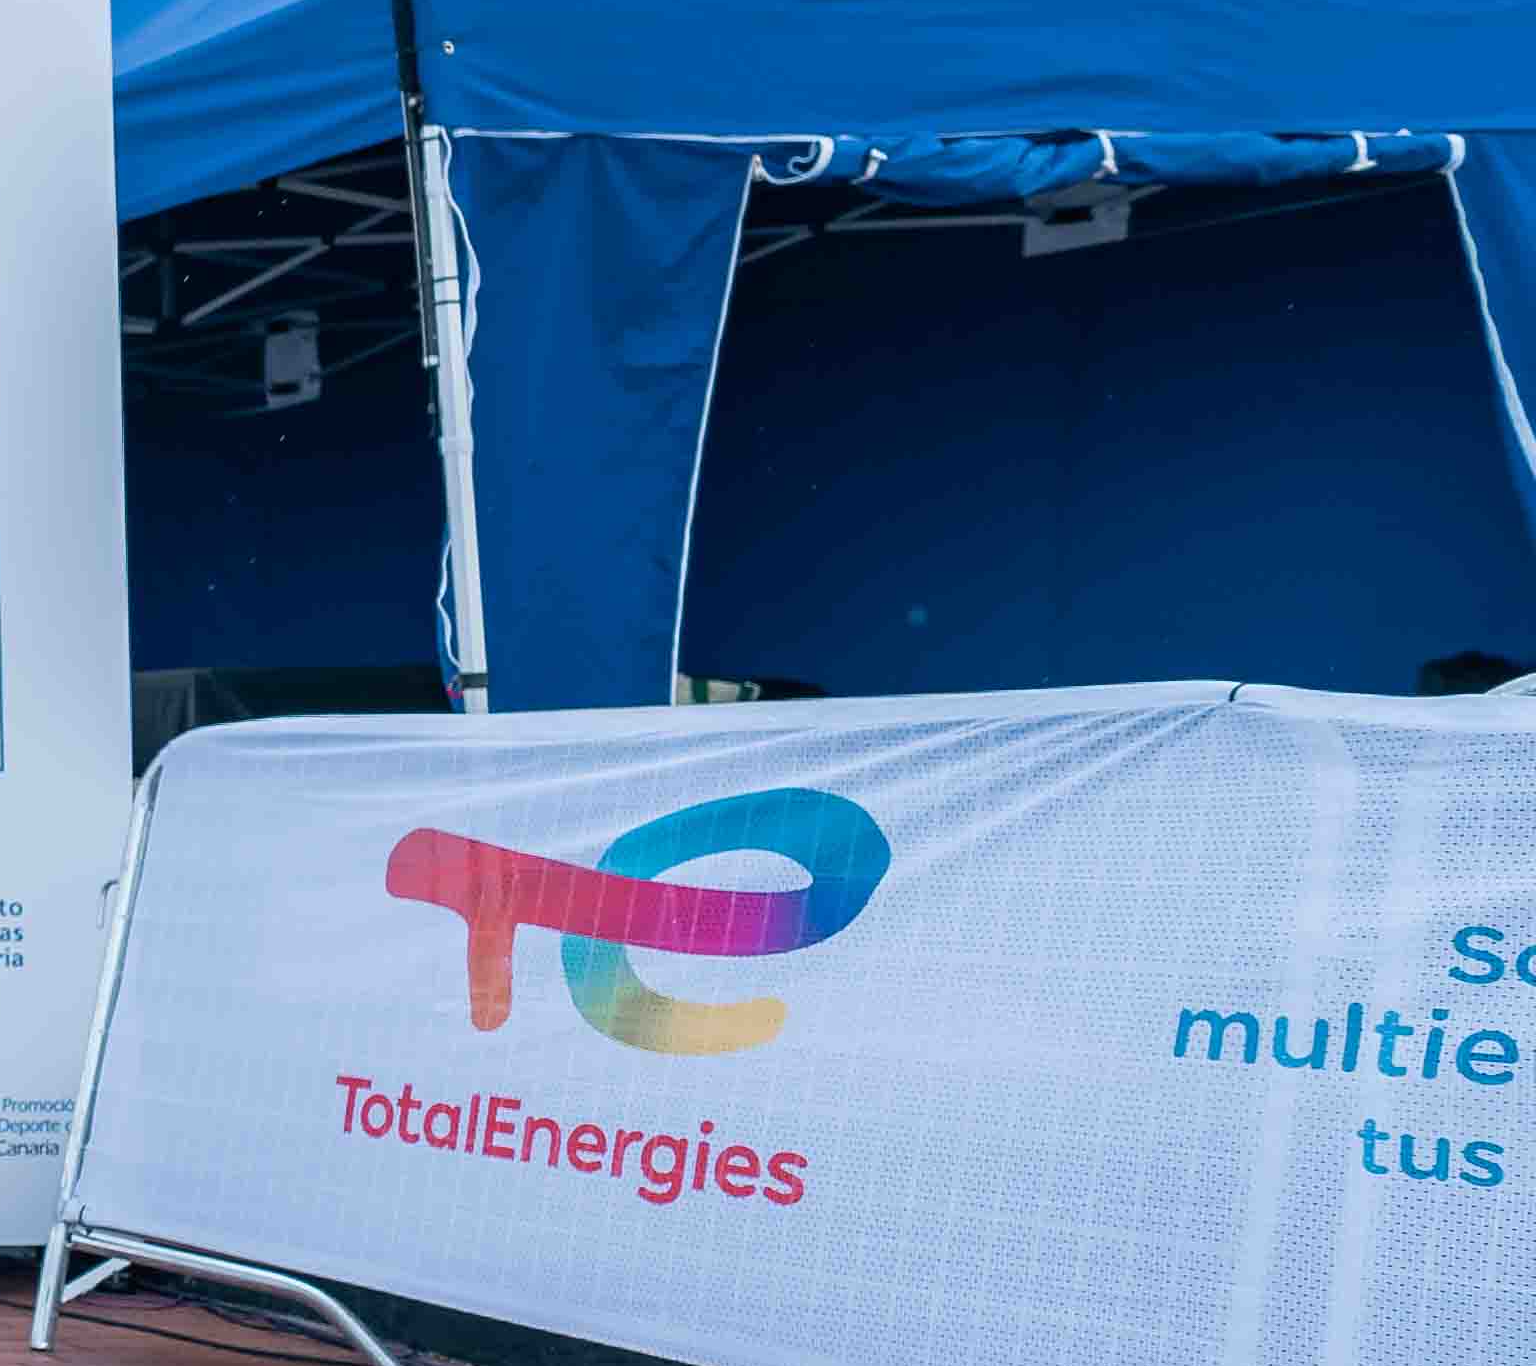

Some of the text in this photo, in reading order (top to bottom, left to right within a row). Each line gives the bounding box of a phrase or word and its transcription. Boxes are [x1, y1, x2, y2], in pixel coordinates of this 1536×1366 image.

[1, 1096, 74, 1114] Promoció
[335, 1075, 810, 1206] TotalEnergies
[1358, 1118, 1506, 1187] tus
